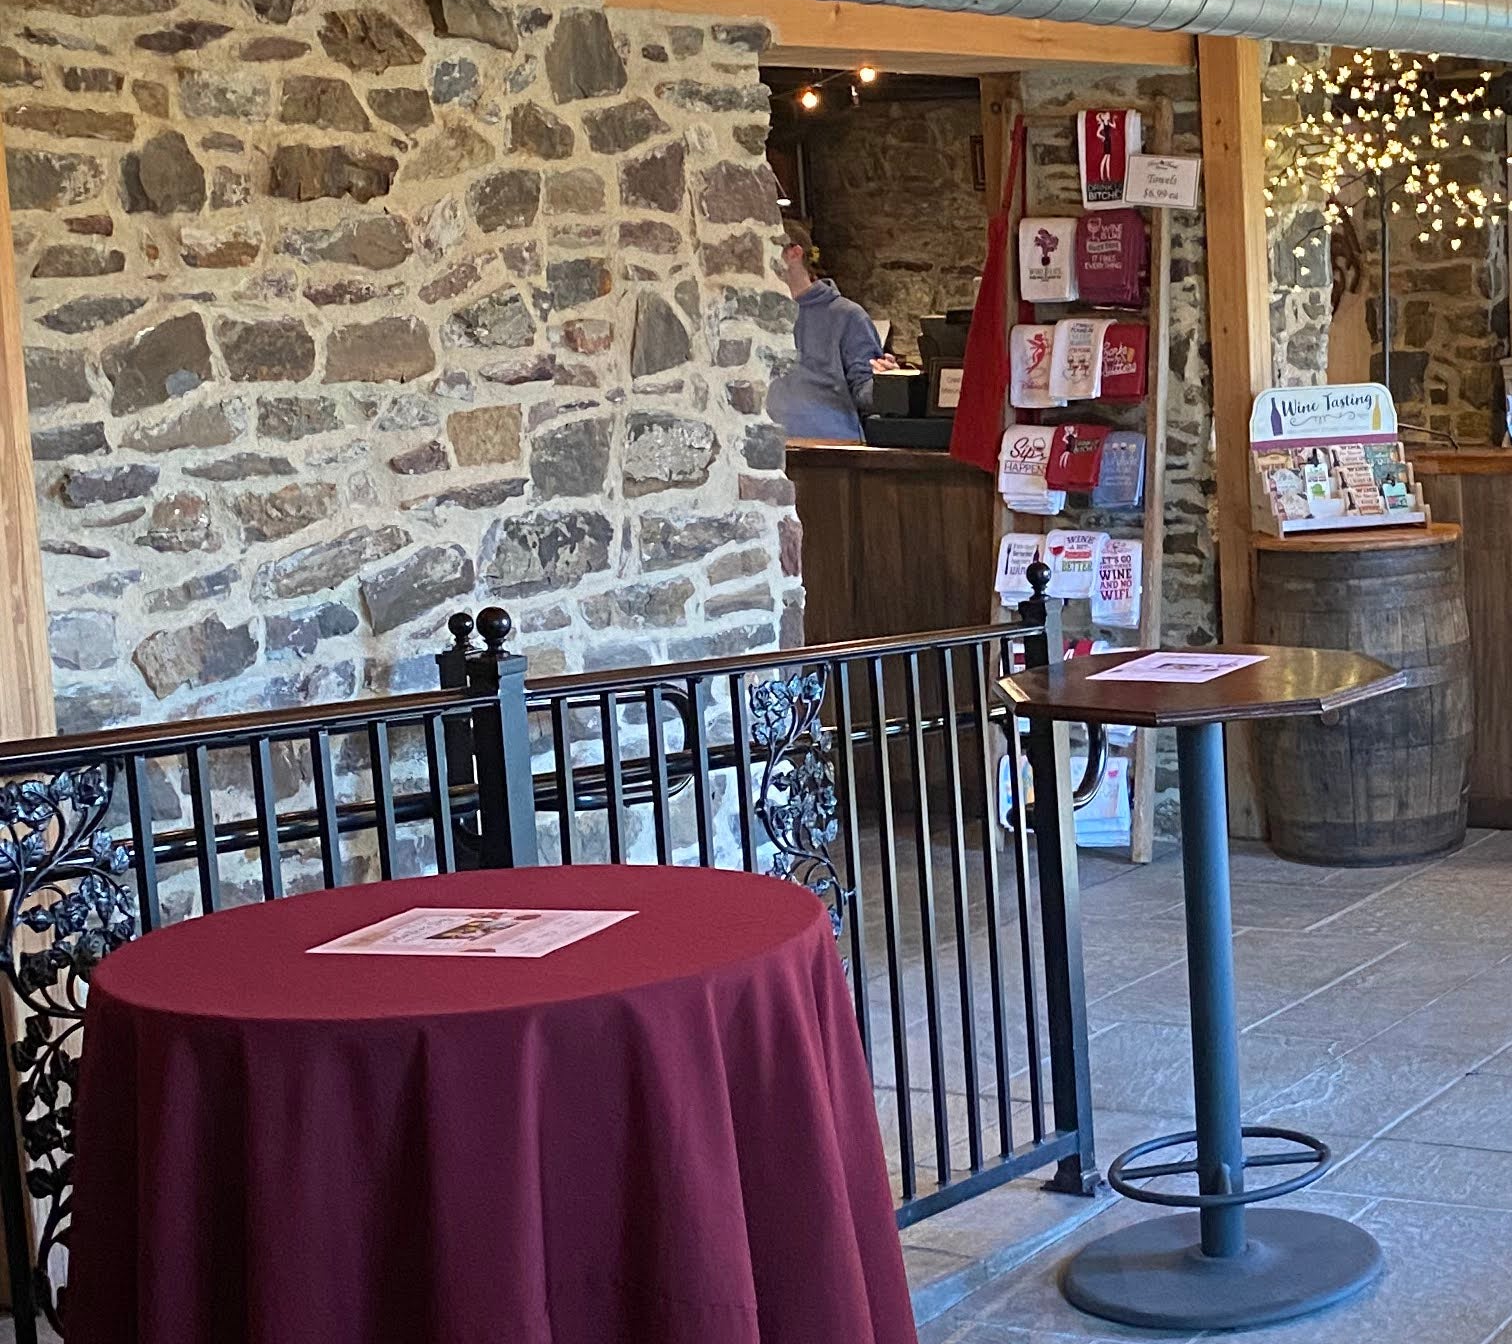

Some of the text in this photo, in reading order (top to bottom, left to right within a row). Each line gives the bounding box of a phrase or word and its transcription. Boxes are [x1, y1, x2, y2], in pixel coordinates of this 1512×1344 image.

[1147, 174, 1178, 185] Towels
[1281, 392, 1373, 417] Wine Tasting
[1010, 437, 1037, 462] Sip
[1004, 462, 1047, 475] HAPPEN
[1066, 535, 1095, 545] WINE
[1062, 560, 1093, 572] BETTER
[1099, 568, 1132, 581] WINE
[1100, 579, 1133, 590] AND NO
